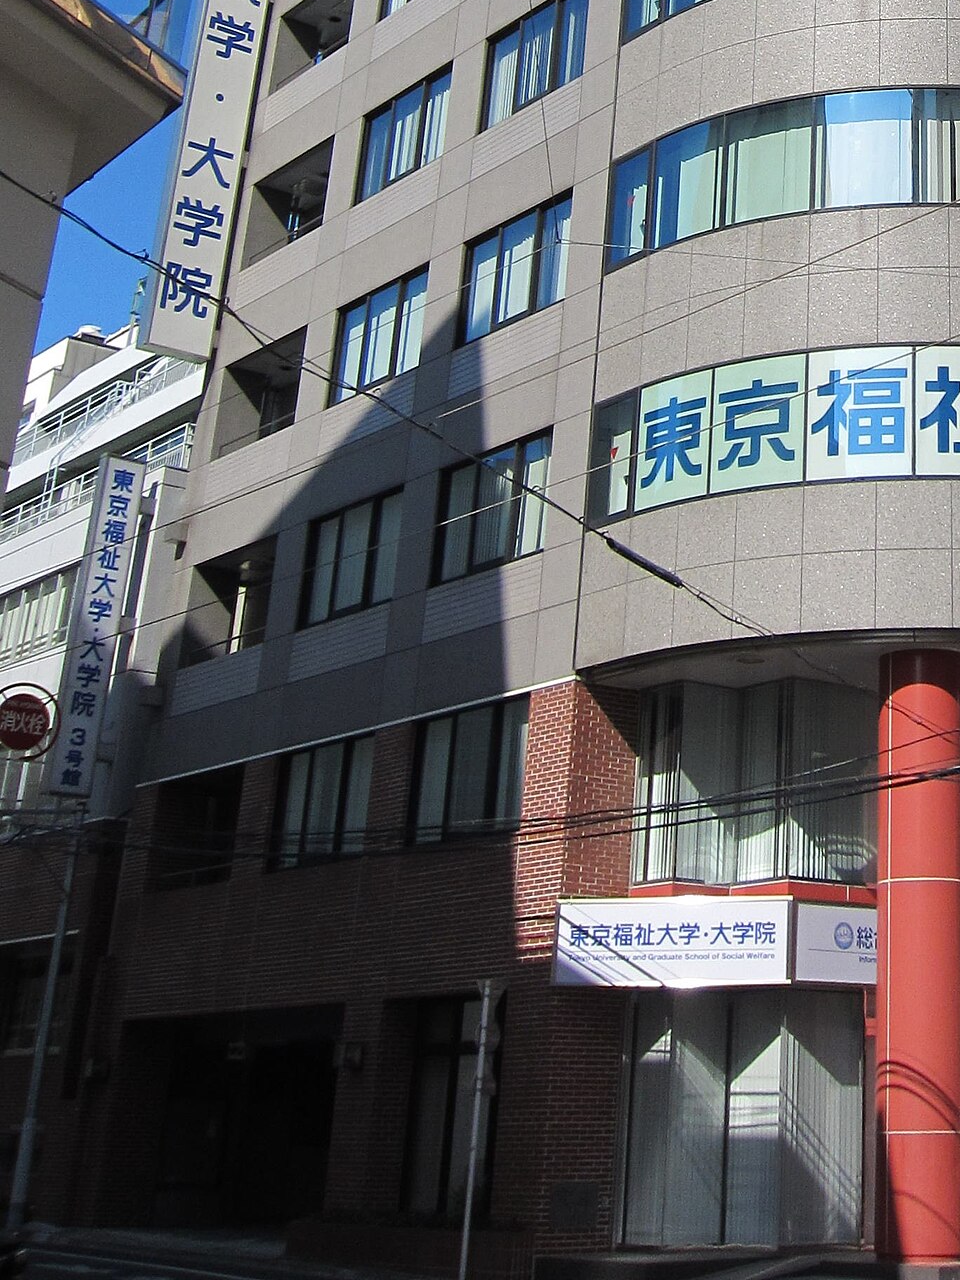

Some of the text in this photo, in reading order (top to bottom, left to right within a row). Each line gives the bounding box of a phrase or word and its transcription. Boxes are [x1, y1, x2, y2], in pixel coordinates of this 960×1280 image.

[0, 710, 46, 735] 消火栓
[569, 922, 776, 947] 東京福祉大学・大学院
[856, 926, 877, 949] 総
[633, 953, 646, 961] and
[648, 953, 682, 961] Graduate
[684, 952, 710, 961] School
[711, 952, 720, 960] of
[721, 952, 745, 960] Social
[746, 951, 775, 960] Welfare
